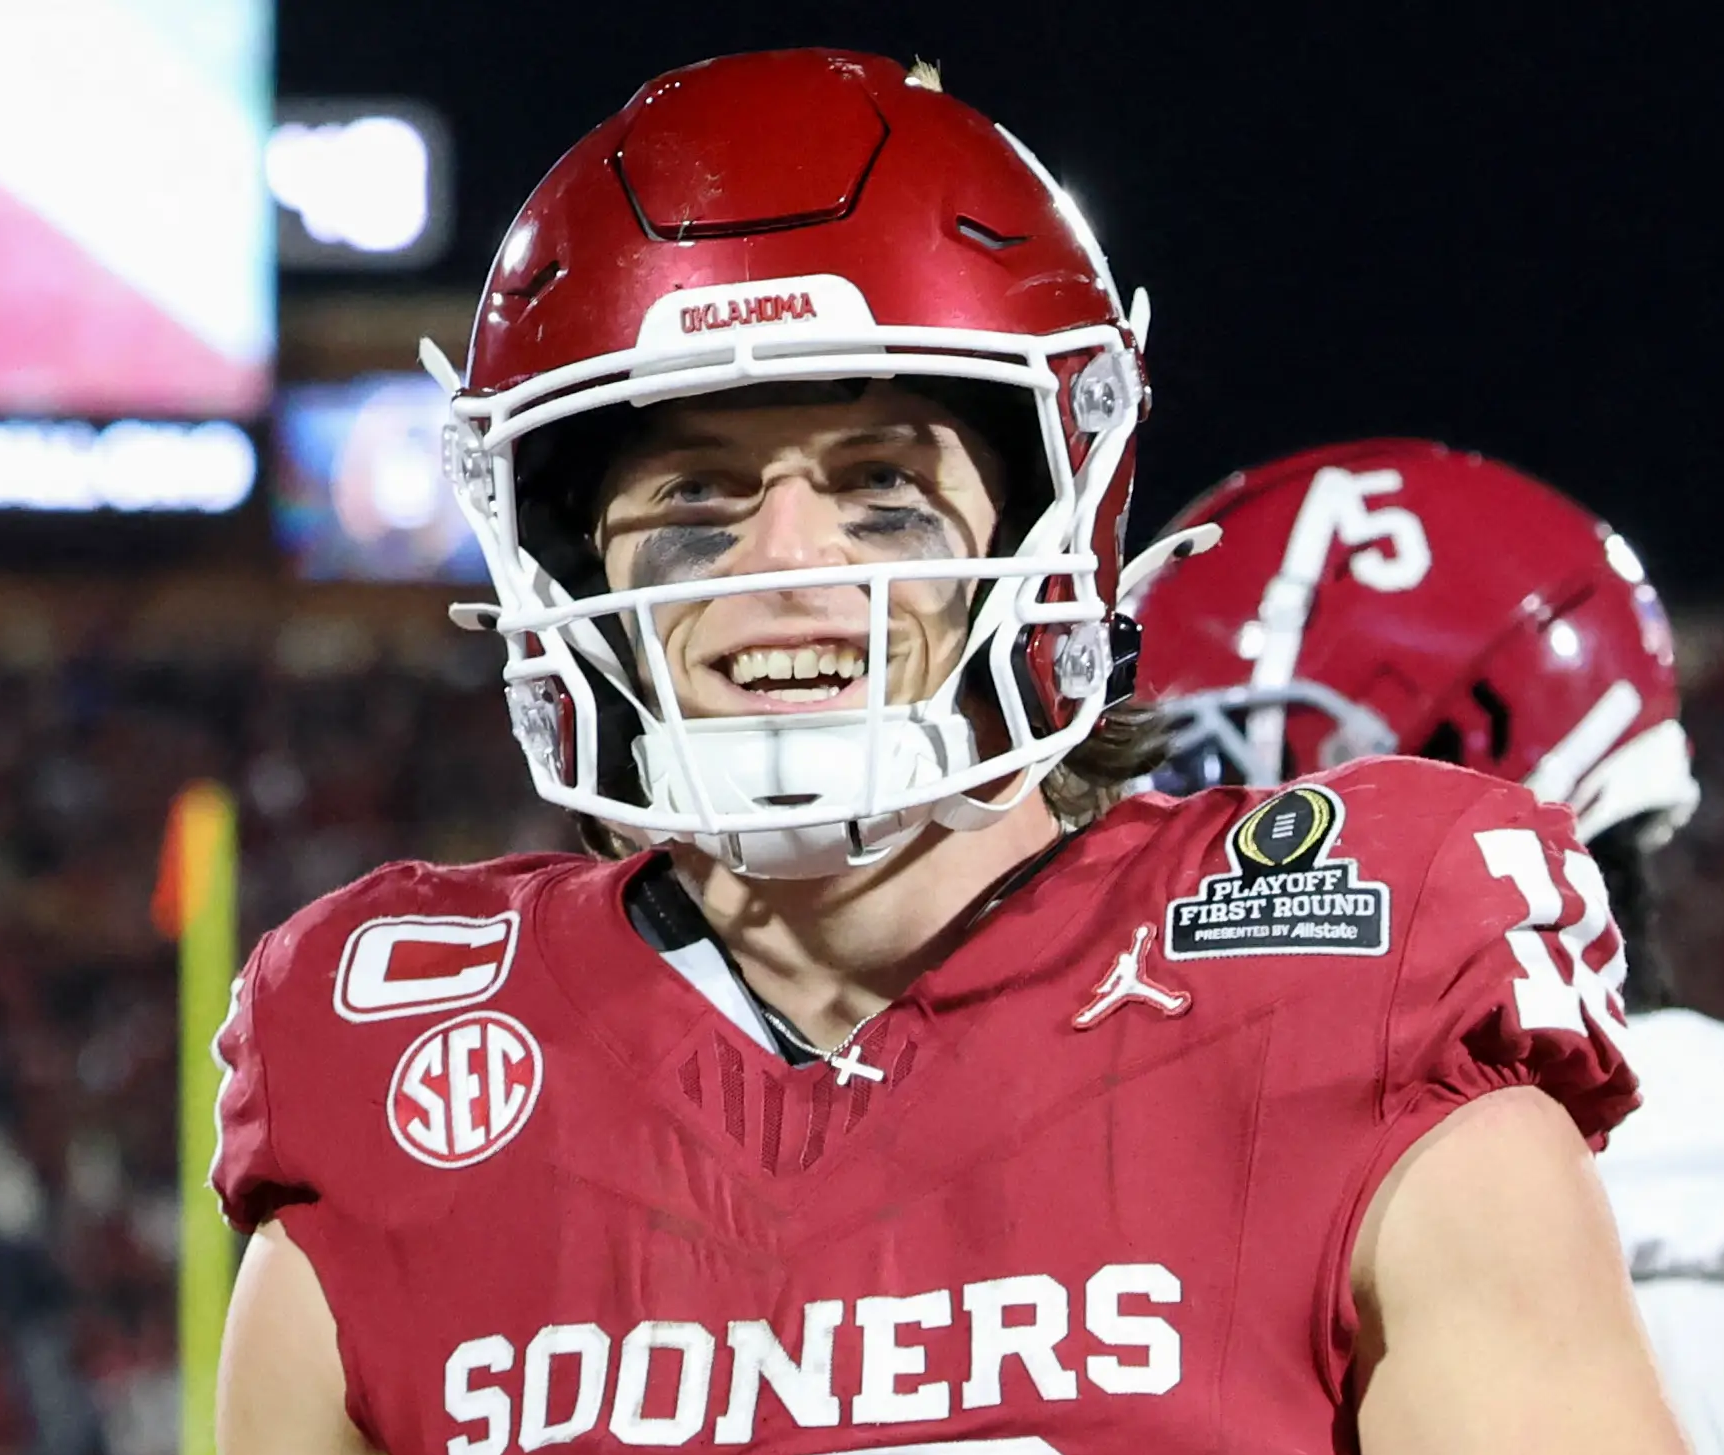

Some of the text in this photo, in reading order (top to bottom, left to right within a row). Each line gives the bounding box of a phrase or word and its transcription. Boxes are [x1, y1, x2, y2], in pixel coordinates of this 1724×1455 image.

[681, 292, 817, 334] OKLAHOMA
[1338, 468, 1432, 593] 5
[1212, 869, 1343, 901] PLAYOFF
[1179, 893, 1375, 926] FIRST ROUND
[1194, 921, 1358, 942] PRESENTED BY Allstate
[346, 921, 508, 1009] C
[401, 1022, 527, 1155] SEC
